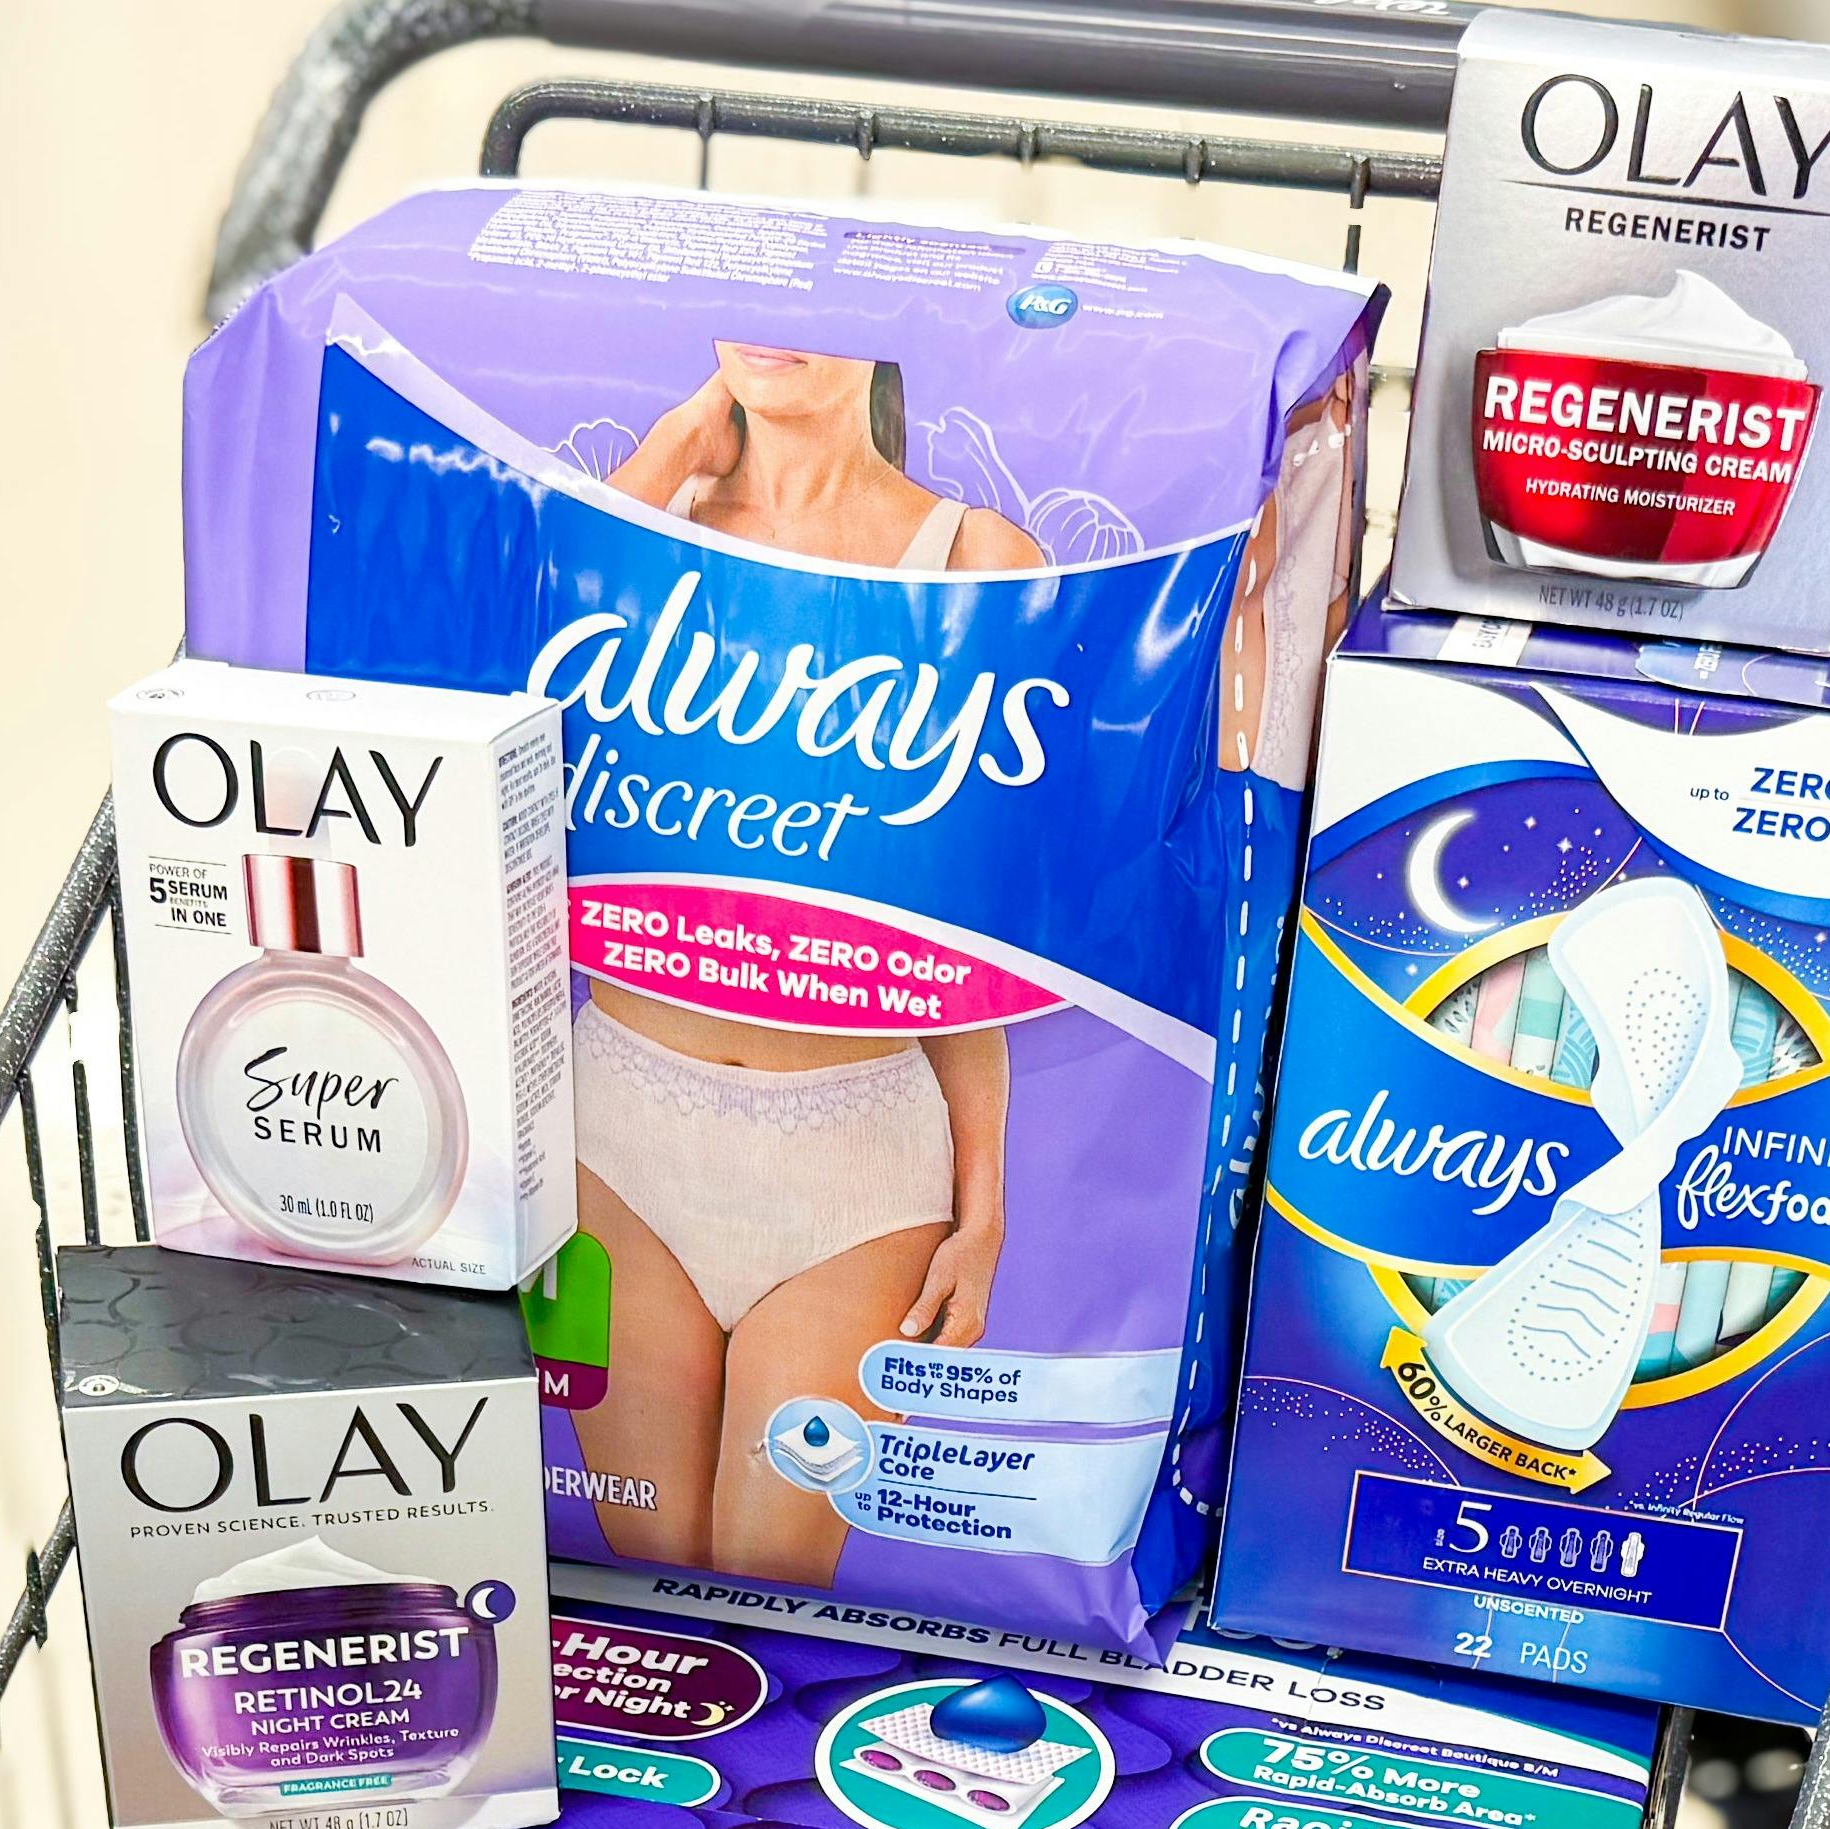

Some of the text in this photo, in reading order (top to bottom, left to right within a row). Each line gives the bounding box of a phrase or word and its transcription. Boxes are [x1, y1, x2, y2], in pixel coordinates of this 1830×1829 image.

[1564, 207, 1772, 252] REGENERIST
[1483, 375, 1807, 452] REGENERIST
[1483, 429, 1792, 484] MICRO-SCULPTING CREAM
[1525, 477, 1735, 517] HYDRATING MOISTURIZER
[1539, 583, 1614, 612] NET WT 48
[527, 569, 1071, 826] always
[151, 732, 444, 848] OLAY
[563, 733, 869, 862] discreet
[1690, 785, 1729, 801] up to
[1732, 807, 1830, 842] ZERO
[149, 863, 207, 879] POWER OF
[150, 877, 227, 904] 5 SERUM
[171, 907, 227, 927] IN ONE
[581, 900, 971, 986] ZERO Leaks, ZERO Odor
[603, 941, 942, 1019] ZERO Bulk When Wet
[244, 1046, 399, 1120] Super
[254, 1116, 381, 1153] SERUM
[1298, 1088, 1571, 1217] always
[280, 1195, 294, 1213] 30
[412, 1257, 486, 1275] ACTUAL SIZE
[882, 1375, 1018, 1404] Body Shapes
[885, 1357, 1021, 1386] Fits 95% of
[1397, 1362, 1513, 1463] 60% LARGER
[121, 1396, 490, 1514] OLAY
[879, 1458, 934, 1480] Core
[880, 1434, 1035, 1473] TripleLayer
[130, 1500, 494, 1538] PROVEN SCIENCE. TRUSTED RESULTS.
[878, 1489, 976, 1518] 12-Hour
[878, 1506, 1012, 1539] Protection
[1449, 1500, 1493, 1553] 5
[1423, 1557, 1652, 1605] EXTRA HEAVY OVERNIGHT
[1473, 1595, 1584, 1625] UNSCENTED
[180, 1627, 469, 1679] REGENERIST
[652, 1577, 1386, 1712] RAPIDLY ABSORBS FULL LOSS
[1453, 1631, 1589, 1675] 22 PADS
[234, 1678, 423, 1715] RETINOL24
[584, 1687, 691, 1719] Night
[250, 1709, 411, 1736] NIGHT CREAM
[201, 1738, 320, 1760] Visibly Repairs
[270, 1746, 394, 1768] and Dark Spots
[569, 1755, 669, 1789] Lock
[1262, 1738, 1481, 1799] 75% More
[1253, 1764, 1448, 1812] Rapid-Absorb
